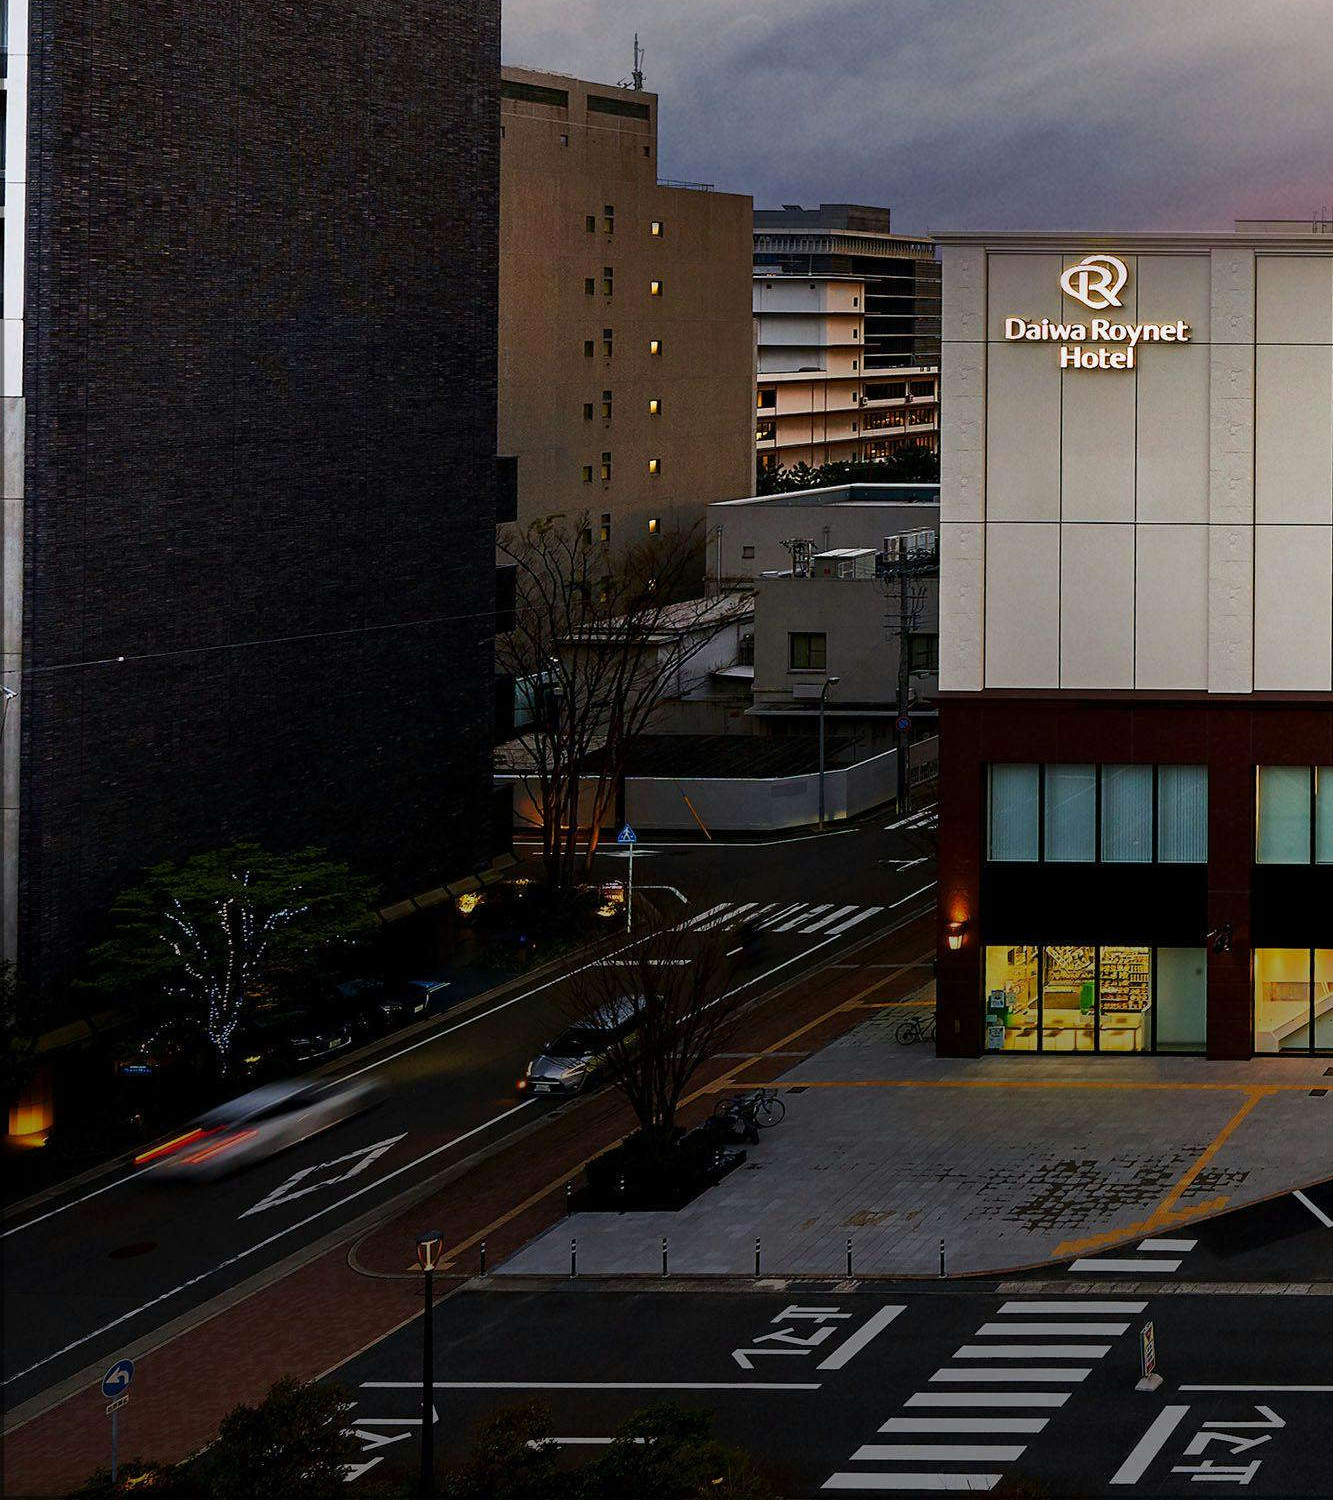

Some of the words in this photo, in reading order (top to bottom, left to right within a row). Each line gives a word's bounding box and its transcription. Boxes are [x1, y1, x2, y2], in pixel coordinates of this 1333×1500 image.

[1005, 317, 1087, 341] Daiwa
[1091, 318, 1190, 347] Roynet
[1060, 346, 1134, 369] Hotel
